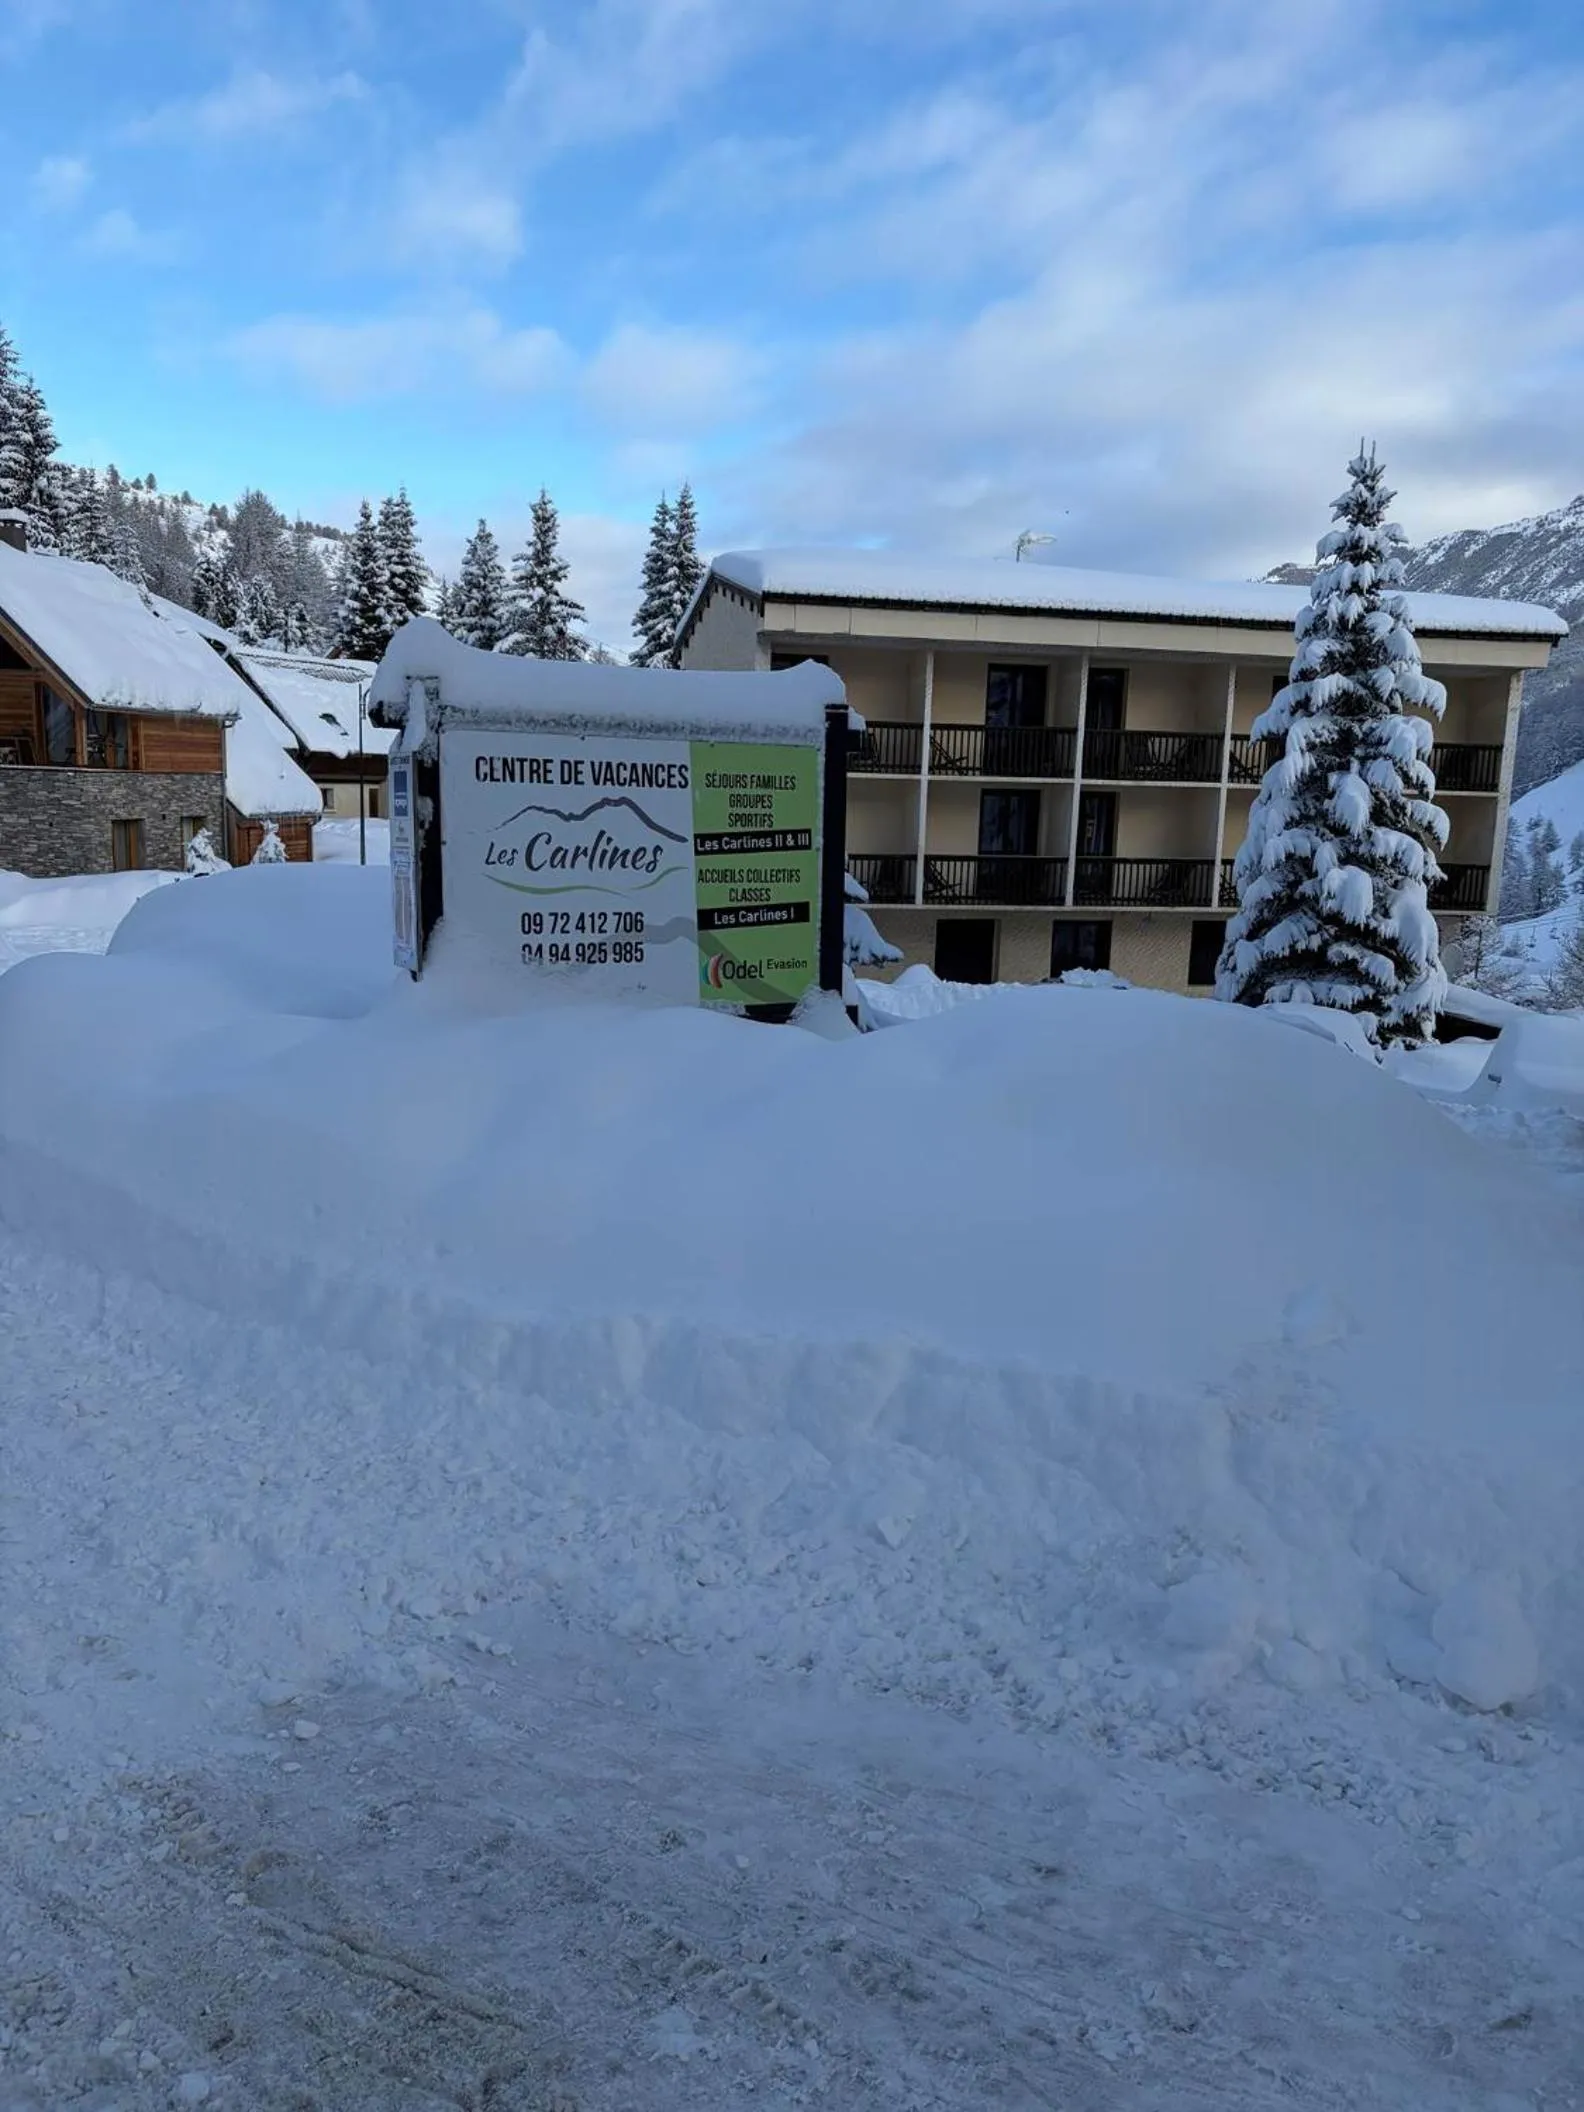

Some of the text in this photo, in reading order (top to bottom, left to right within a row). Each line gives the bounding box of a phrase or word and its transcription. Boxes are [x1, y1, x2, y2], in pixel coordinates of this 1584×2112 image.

[560, 760, 585, 785] DE
[590, 761, 689, 789] VACANCES
[749, 774, 796, 790] FAMILLES
[729, 794, 773, 809] GROUPES
[728, 812, 774, 828] SPORTIFS
[697, 838, 719, 851] Les
[722, 835, 772, 849] Carlines
[786, 833, 795, 846] &
[484, 830, 663, 873] Les Carlines
[698, 868, 801, 884] ACCUEILS COLLECTIFS
[729, 887, 771, 902] CLASSES
[521, 912, 644, 935] 09 72 412 706
[714, 911, 736, 925] Les
[739, 908, 788, 923] Carlines
[548, 943, 571, 964] 94
[575, 942, 607, 964] 925
[612, 942, 644, 963] 985
[722, 958, 808, 980] Odel Evasion
